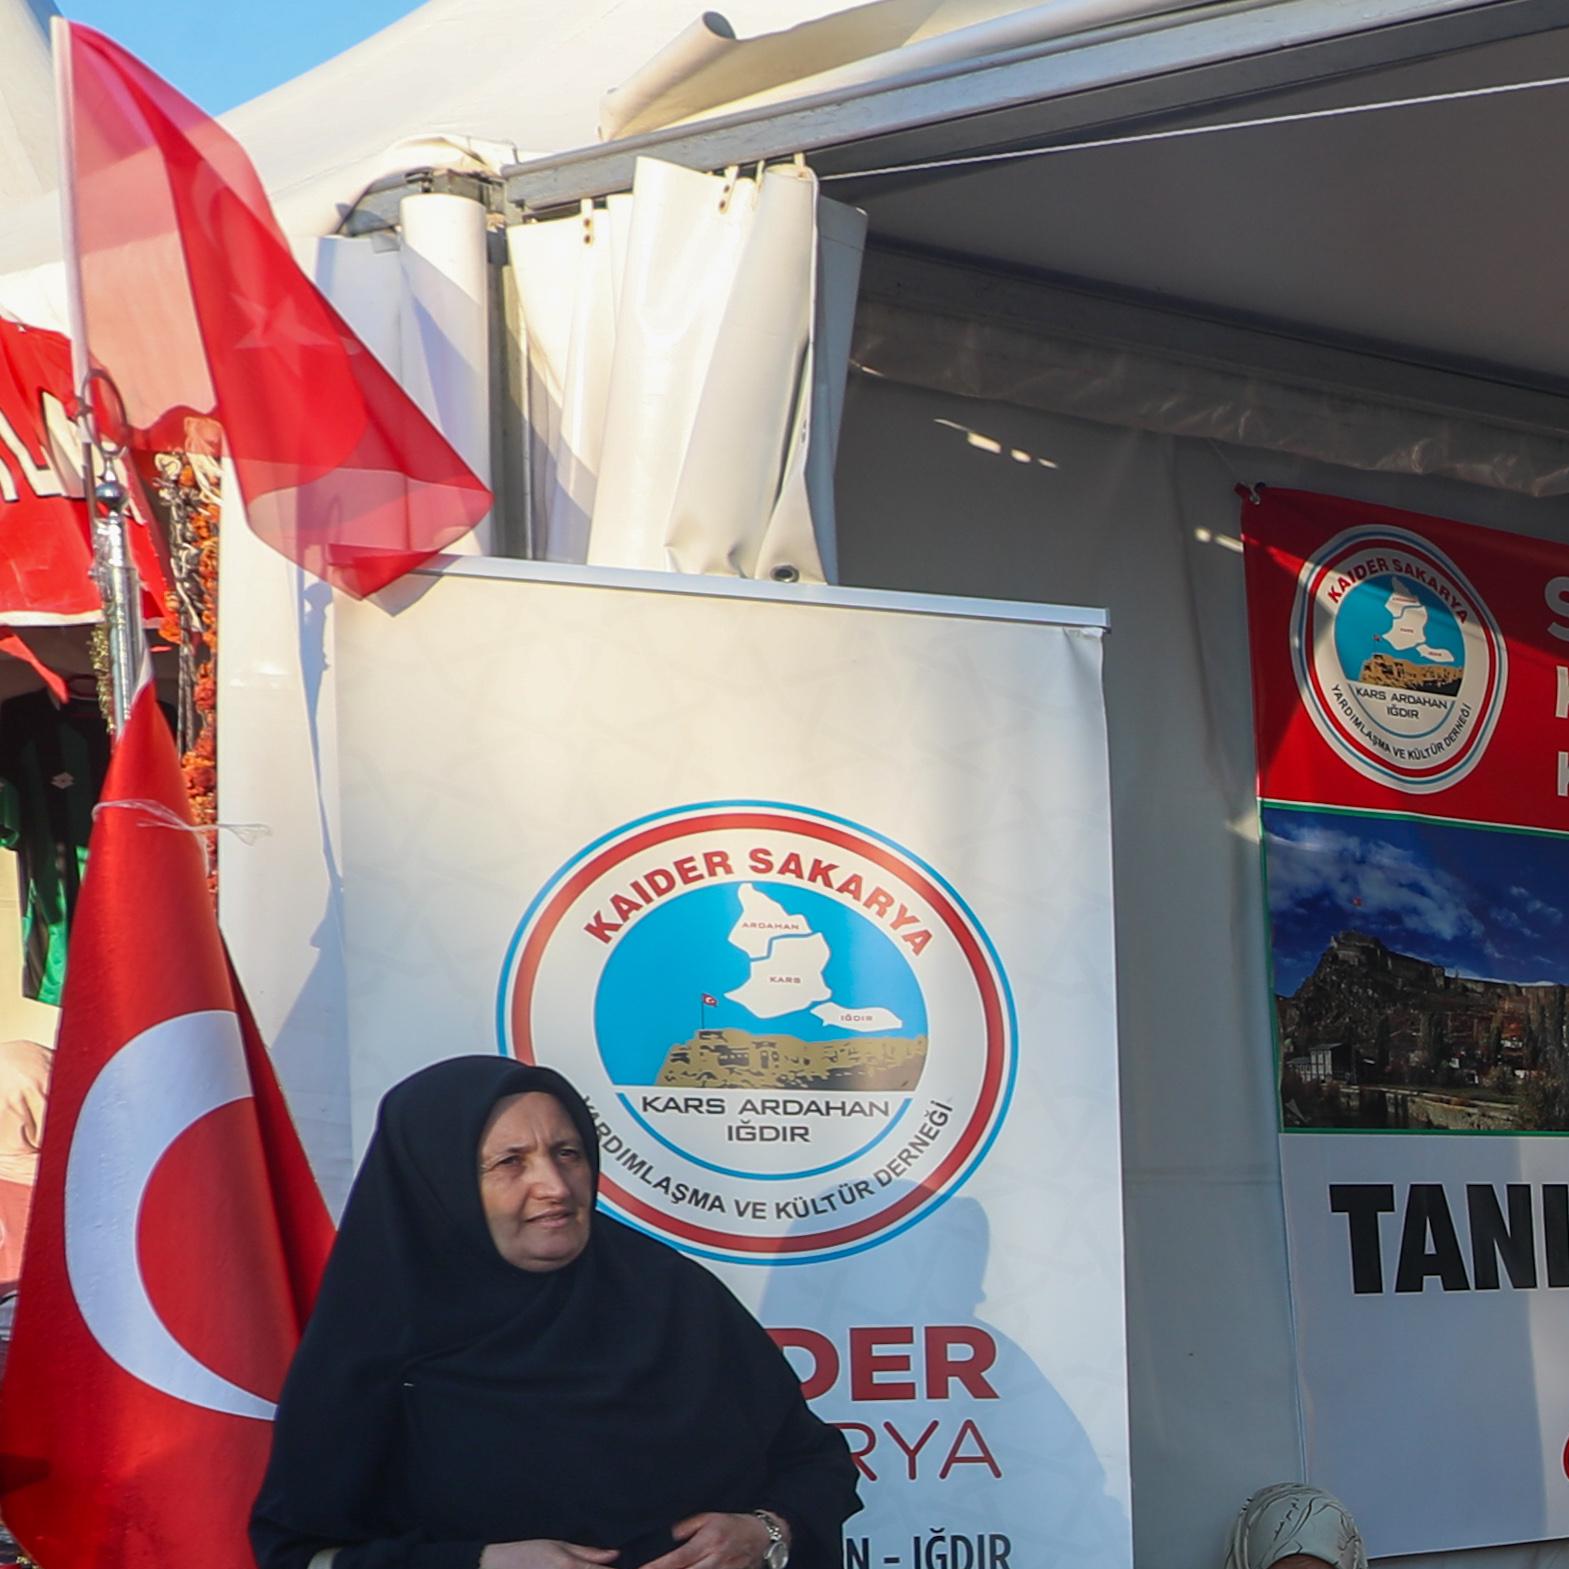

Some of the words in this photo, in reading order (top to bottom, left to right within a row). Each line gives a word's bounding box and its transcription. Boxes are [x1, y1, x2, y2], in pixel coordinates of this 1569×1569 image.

[1327, 557, 1390, 604] KAIDER
[1391, 558, 1469, 625] SAKARYA
[1355, 687, 1386, 701] KARS
[1391, 693, 1448, 710] ARDAHAN
[1331, 684, 1391, 753] YARDIMLAŞMA
[1392, 747, 1407, 760] VE
[1406, 741, 1445, 761] KÜLTÜR
[1386, 703, 1420, 720] IĞDIR
[583, 848, 735, 945] KAIDER
[747, 847, 934, 957] SAKARYA
[741, 921, 801, 931] ARDAHAN
[769, 976, 801, 984] KARS
[840, 1013, 873, 1022] IĞDIR
[641, 1095, 727, 1116] KARS
[737, 1097, 890, 1118] ARDAHAN
[726, 1120, 811, 1143] IĞDIR
[733, 1200, 767, 1220] VE
[775, 1179, 876, 1220] KÜLTÜR
[873, 1098, 954, 1188] DERNEĞİ
